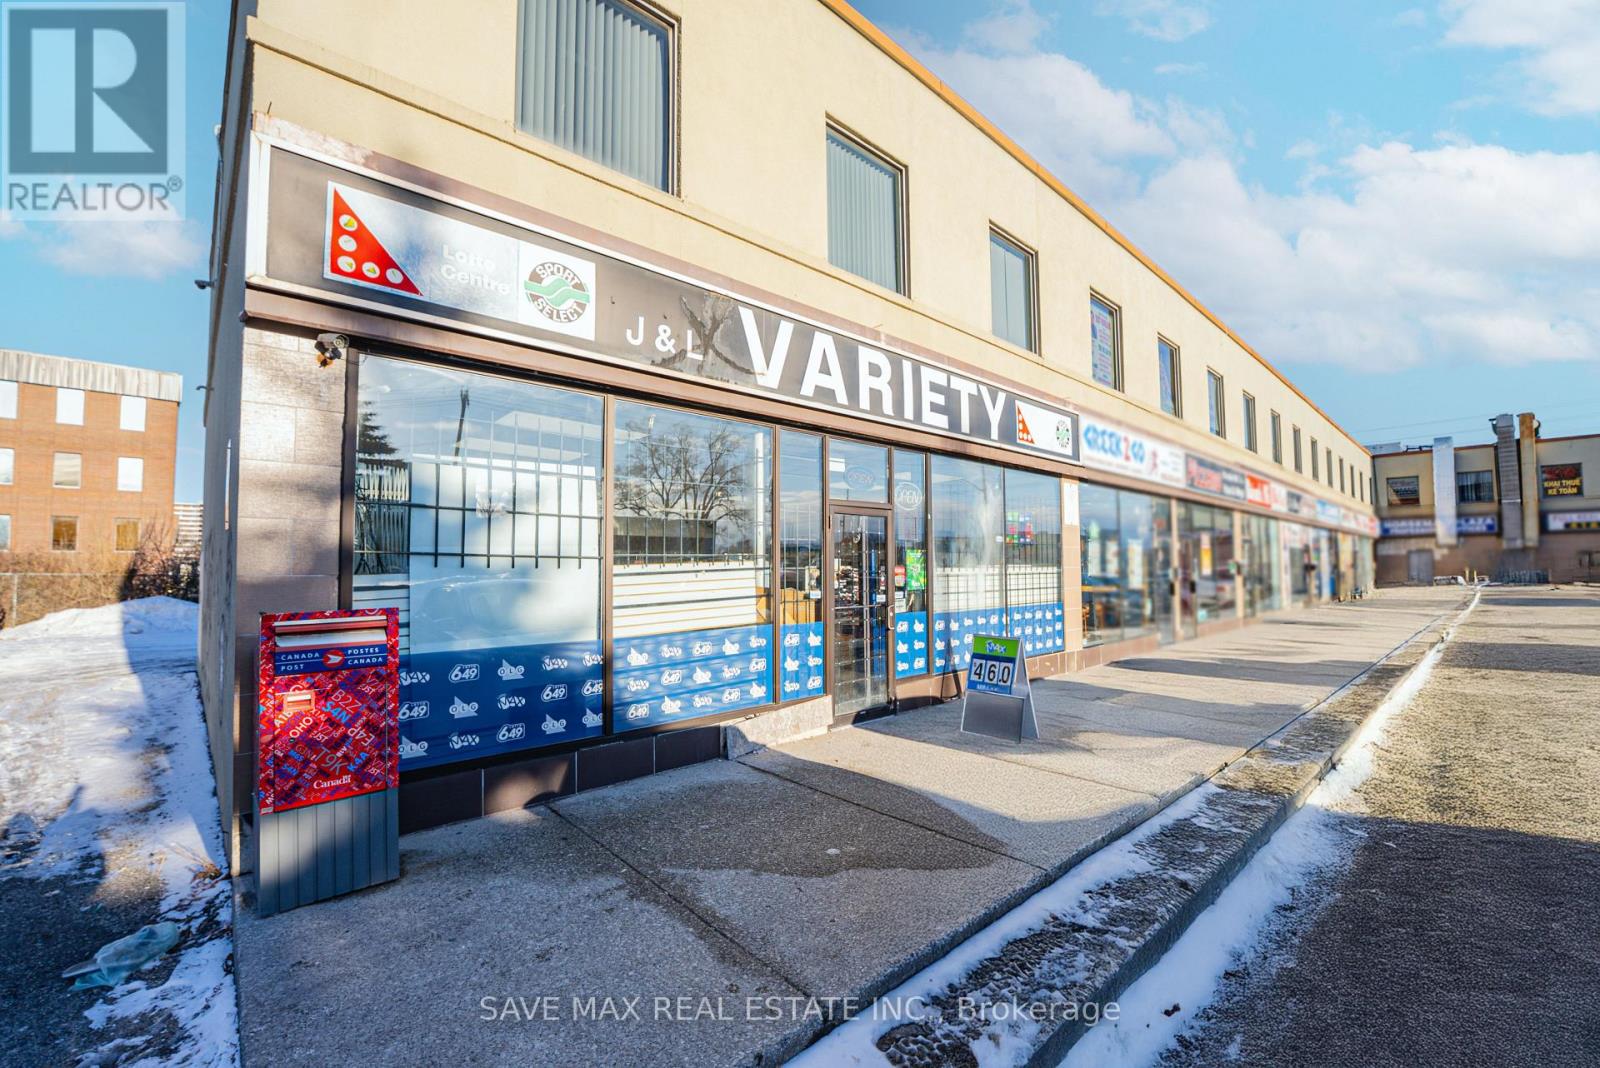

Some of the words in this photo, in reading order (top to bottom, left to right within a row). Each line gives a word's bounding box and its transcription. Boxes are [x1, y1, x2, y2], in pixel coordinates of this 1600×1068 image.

[442, 244, 495, 272] Lotto
[441, 263, 512, 294] Centre
[536, 263, 580, 286] SPORT
[535, 298, 583, 322] SELECT
[626, 316, 644, 345] J
[655, 325, 675, 354] &
[687, 330, 703, 360] L
[738, 305, 1006, 440] VARIETY
[281, 652, 320, 661] CANADA
[347, 647, 379, 655] POSTES
[347, 657, 383, 665] CANADA
[450, 665, 478, 681] 649
[542, 686, 566, 700] 649
[399, 704, 427, 719] 649
[498, 726, 523, 740] 649
[313, 775, 352, 789] Canada
